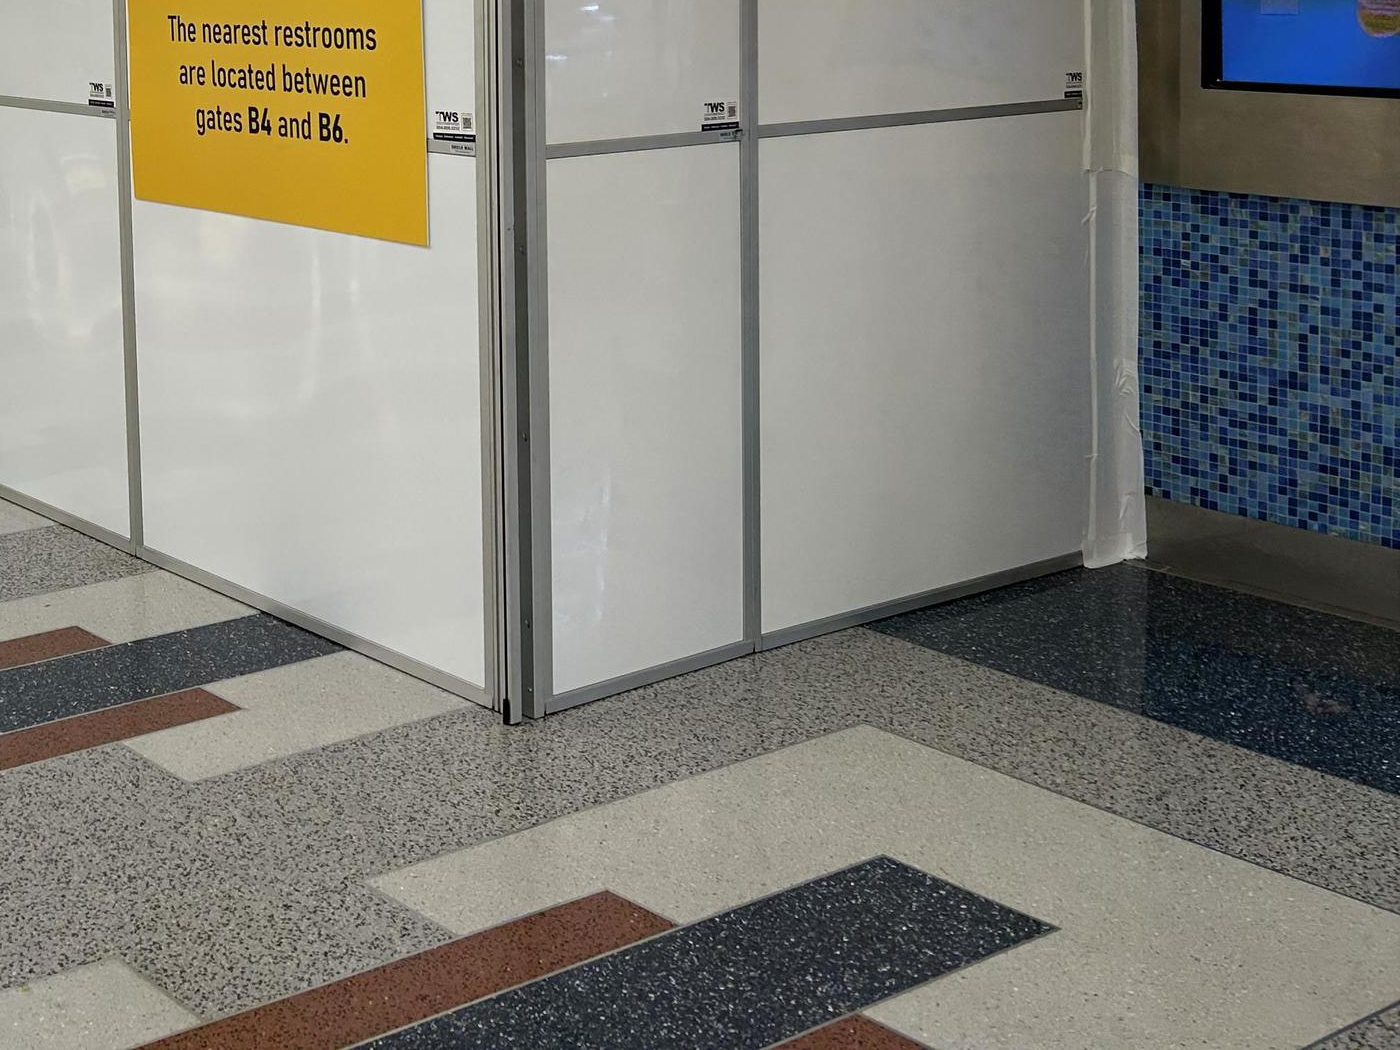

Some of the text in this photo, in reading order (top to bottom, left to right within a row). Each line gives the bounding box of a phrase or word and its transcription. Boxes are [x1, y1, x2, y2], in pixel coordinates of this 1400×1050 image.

[168, 15, 377, 50] The nearest restrooms
[179, 60, 366, 98] are located between
[196, 105, 349, 144] gates B4 and B6.
[435, 111, 459, 122] TWS
[704, 102, 725, 113] TWS
